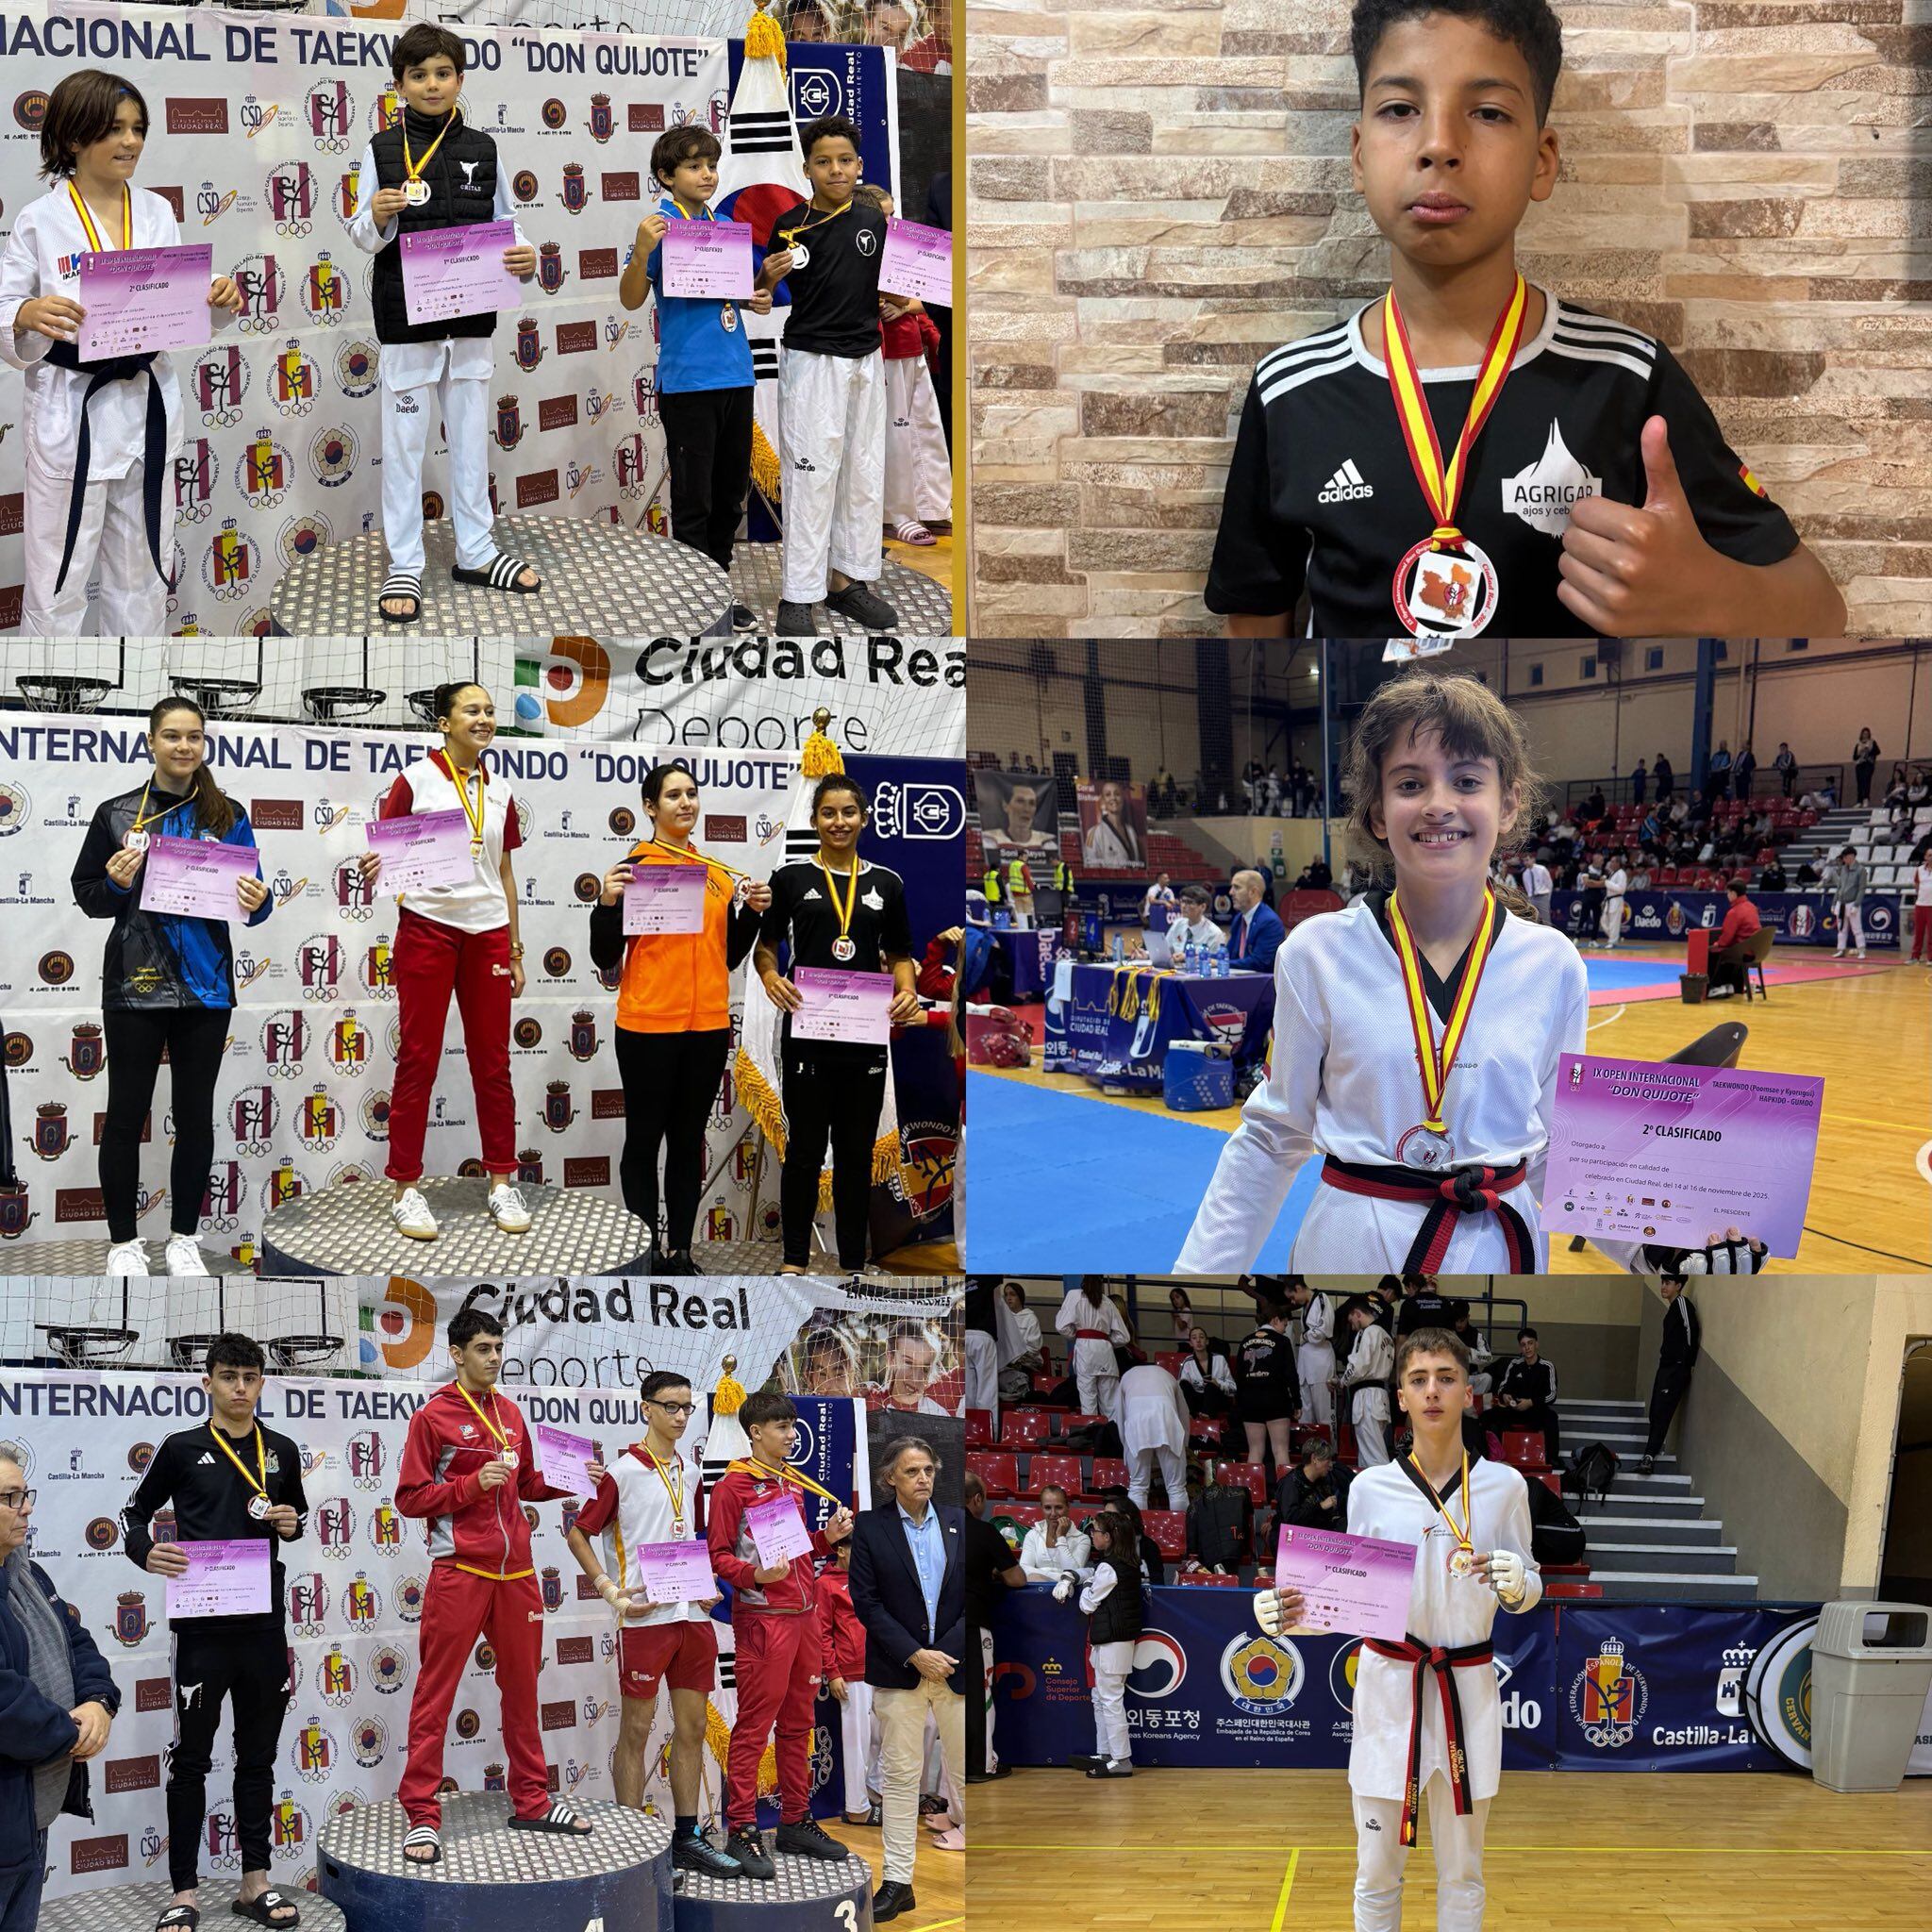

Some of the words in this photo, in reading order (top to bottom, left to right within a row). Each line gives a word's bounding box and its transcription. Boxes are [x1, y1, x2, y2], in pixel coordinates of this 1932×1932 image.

[225, 25, 278, 63] DE
[241, 105, 262, 126] CSD
[197, 192, 219, 214] CSD
[136, 281, 170, 291] CLASIFICADO
[395, 403, 420, 414] Daedo
[794, 462, 816, 473] Daedo
[1318, 480, 1374, 504] adidas
[1522, 506, 1543, 517] ajos
[1545, 508, 1552, 516] y
[634, 637, 846, 687] Ciudad
[305, 739, 351, 773] DE
[43, 818, 77, 827] Castilla-La
[314, 807, 334, 825] CSD
[543, 830, 569, 839] Castilla-La
[756, 820, 773, 839] CSD
[273, 878, 292, 897] CSD
[30, 896, 55, 905] Mancha
[1635, 915, 1662, 928] Daedo
[1071, 921, 1076, 934] 2
[1088, 922, 1095, 937] 4
[236, 958, 255, 978] CSD
[1070, 1024, 1094, 1035] CIUDAD
[1593, 1067, 1603, 1077] IX
[1604, 1068, 1628, 1081] OPEN
[1629, 1071, 1700, 1089] INTERNACIONAL
[1712, 1080, 1749, 1091] TAEKWONDO
[1759, 1095, 1787, 1105] HAPKIDO
[1790, 1098, 1814, 1108] GUMDO
[1656, 1124, 1723, 1142] CLASIFICADO
[1571, 1140, 1600, 1150] Otorgado
[1590, 1158, 1628, 1168] participación
[1638, 1163, 1660, 1172] calidad
[1585, 1173, 1615, 1182] celebrado
[1624, 1176, 1646, 1186] Ciudad
[1707, 1187, 1742, 1197] noviembre
[1721, 1208, 1751, 1217] PRESIDENTE
[650, 1282, 750, 1330] Real
[501, 1348, 655, 1388] eporte
[285, 1389, 326, 1419] DE
[818, 1402, 826, 1431] Real
[818, 1435, 826, 1482] Ciudad
[48, 1472, 80, 1480] Castilla-La
[37, 1549, 61, 1557] Mancha
[1332, 1566, 1367, 1578] CLASIFICADO
[1586, 1658, 1624, 1673] ESPAÑOLA
[1624, 1662, 1635, 1674] DE
[1045, 1677, 1078, 1687] Consejo
[1045, 1686, 1080, 1695] Superior
[1569, 1669, 1588, 1713] FEDERACIÓN
[1633, 1669, 1649, 1714] TAEKWONDO
[1216, 1718, 1311, 1729] 주스페인대한민국대사관
[1574, 1715, 1588, 1730] REAL
[1174, 1732, 1201, 1741] Agency
[1216, 1728, 1244, 1737] Embajada
[1259, 1728, 1286, 1737] República
[1652, 1724, 1747, 1747] Castilla-La
[110, 1781, 138, 1790] CIUDAD
[139, 1778, 157, 1787] REAL
[142, 1836, 160, 1857] CSD
[75, 1860, 105, 1870] CIUDAD
[107, 1858, 125, 1867] REAL
